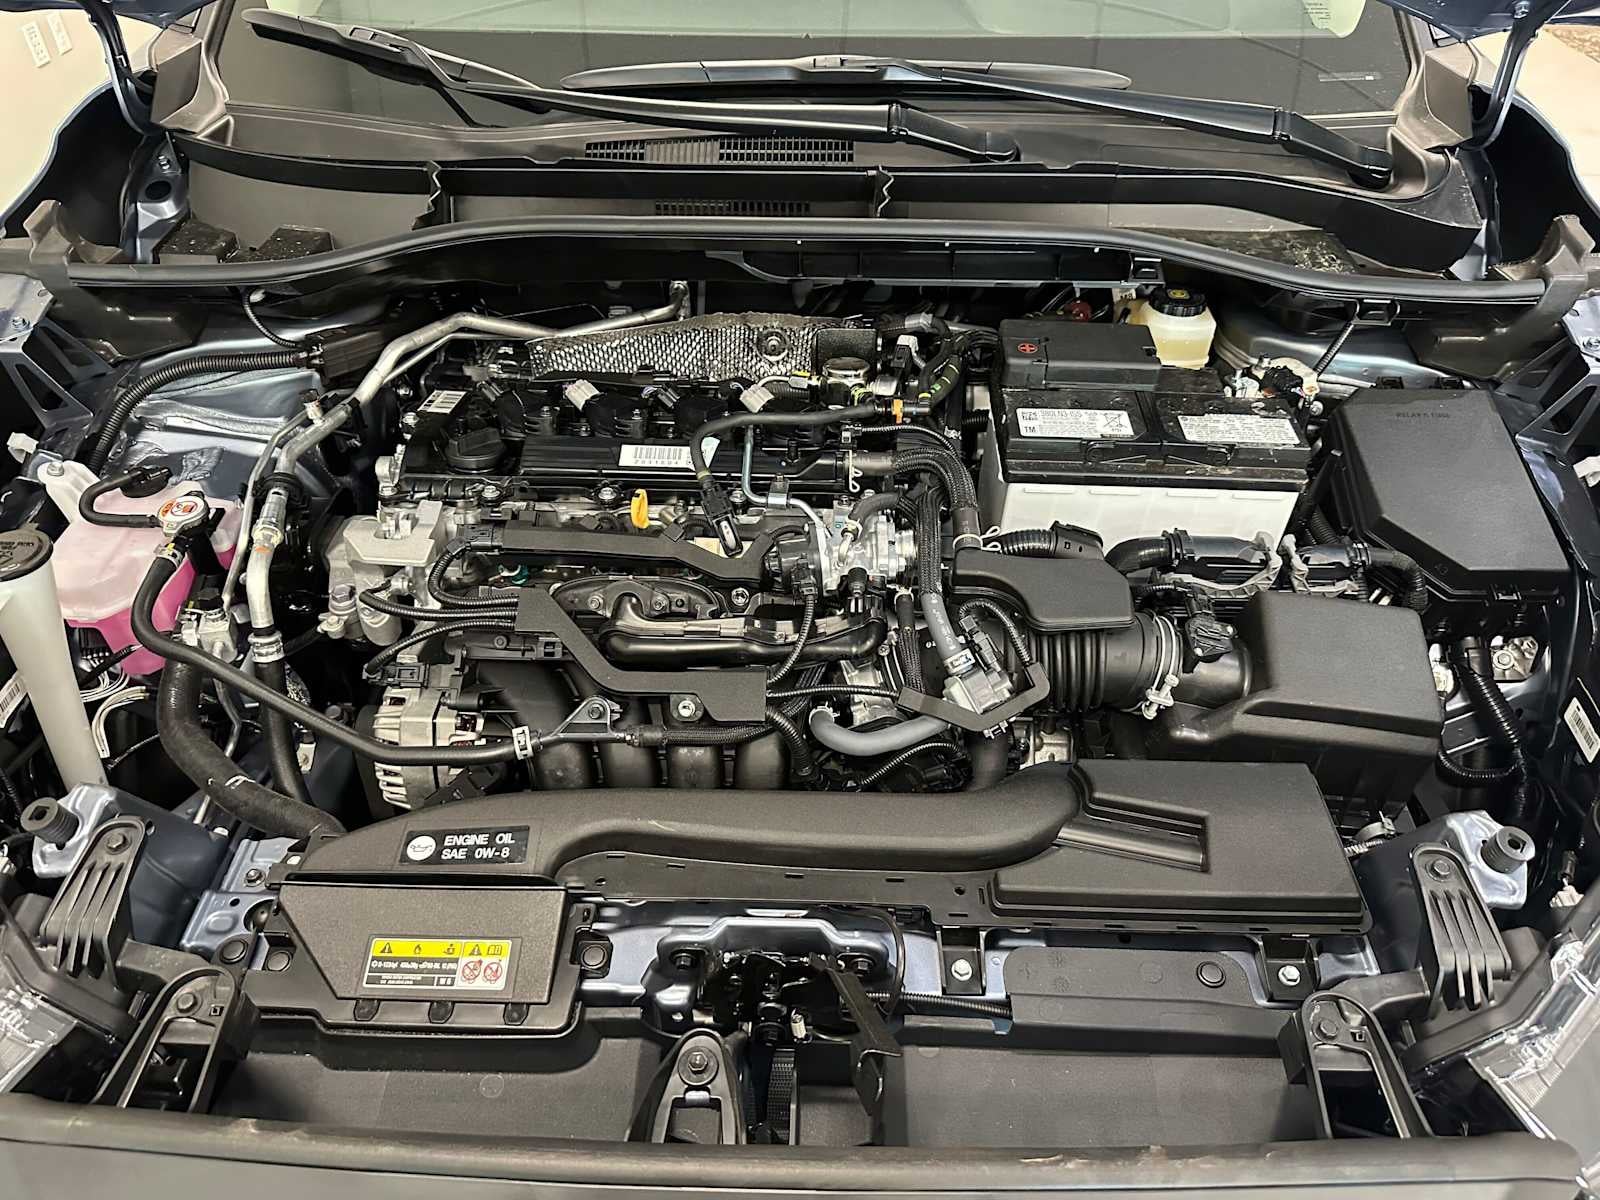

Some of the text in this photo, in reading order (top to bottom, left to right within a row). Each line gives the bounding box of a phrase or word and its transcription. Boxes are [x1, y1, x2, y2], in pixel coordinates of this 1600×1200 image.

[443, 832, 516, 847] ENGINE OIL
[440, 847, 510, 860] SAE 0W-8
